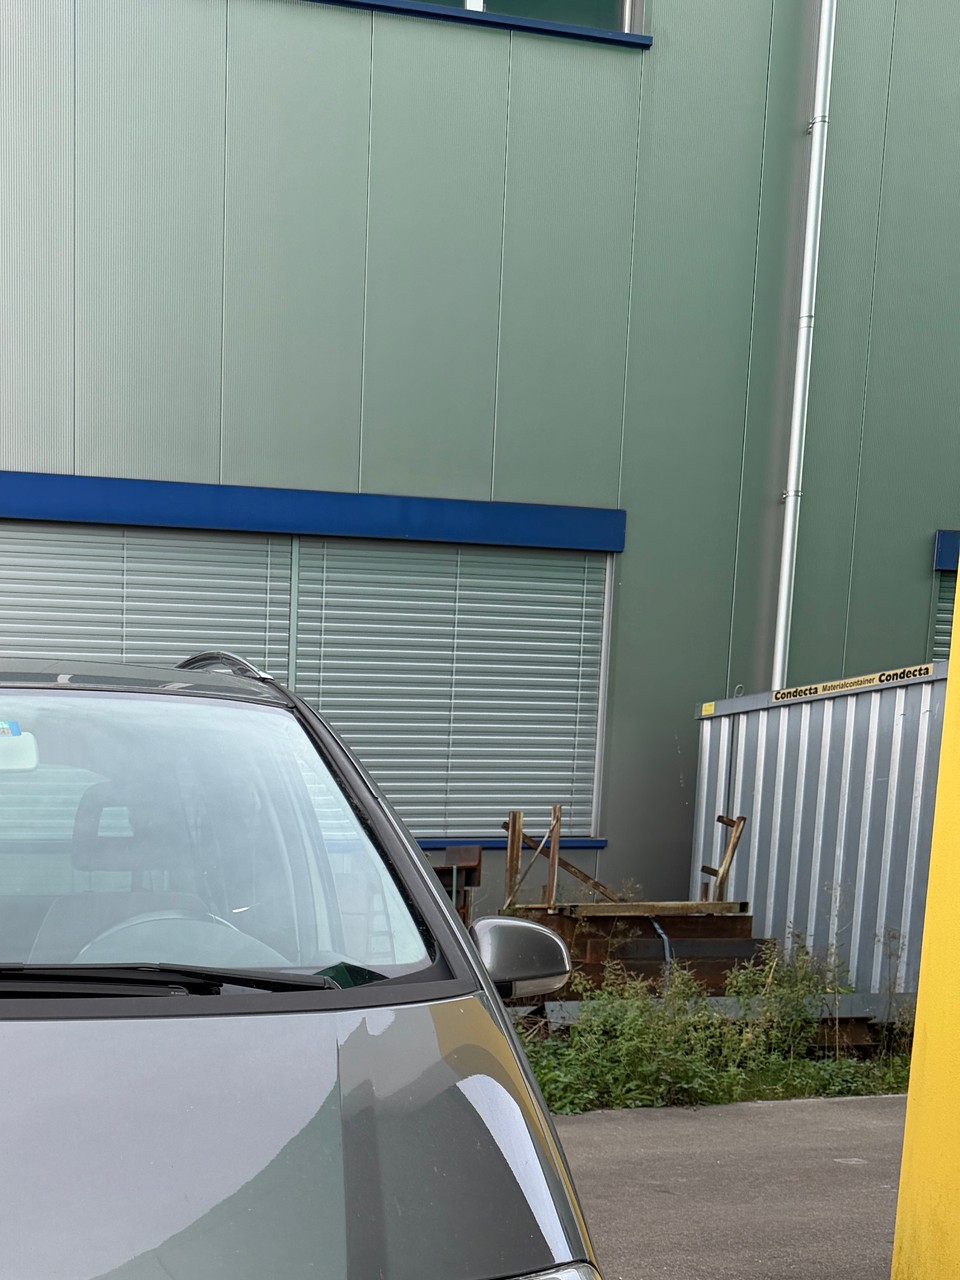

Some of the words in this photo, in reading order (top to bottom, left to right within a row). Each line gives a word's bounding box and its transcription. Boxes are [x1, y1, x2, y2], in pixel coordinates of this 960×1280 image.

[774, 687, 818, 701] Condecta
[822, 677, 875, 692] Materialcontainer
[878, 666, 929, 683] Condecta
